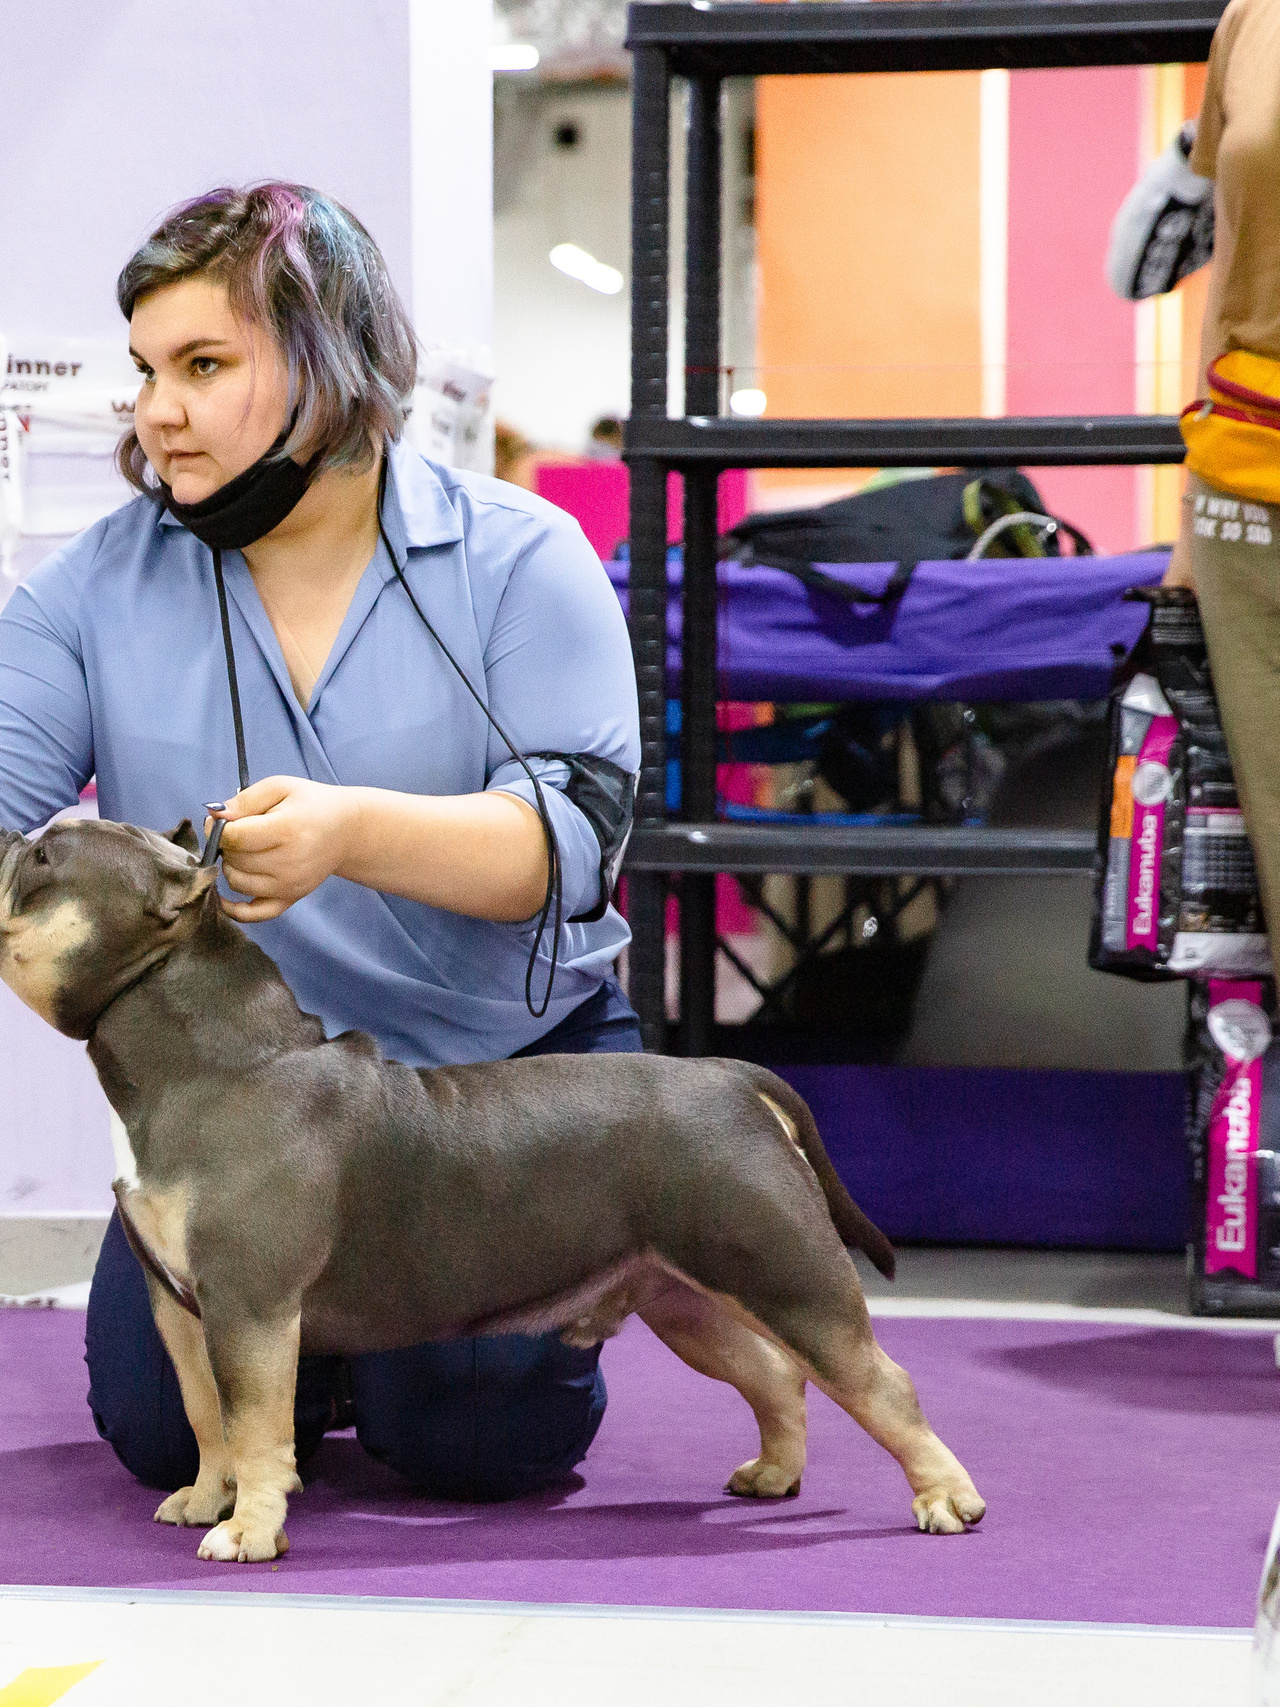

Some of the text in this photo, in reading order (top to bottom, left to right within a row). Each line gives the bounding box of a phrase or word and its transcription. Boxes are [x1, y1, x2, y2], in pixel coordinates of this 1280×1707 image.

[6, 353, 83, 377] inner
[1132, 813, 1159, 936] Eukanuba
[1215, 1077, 1252, 1252] Eukanuba
